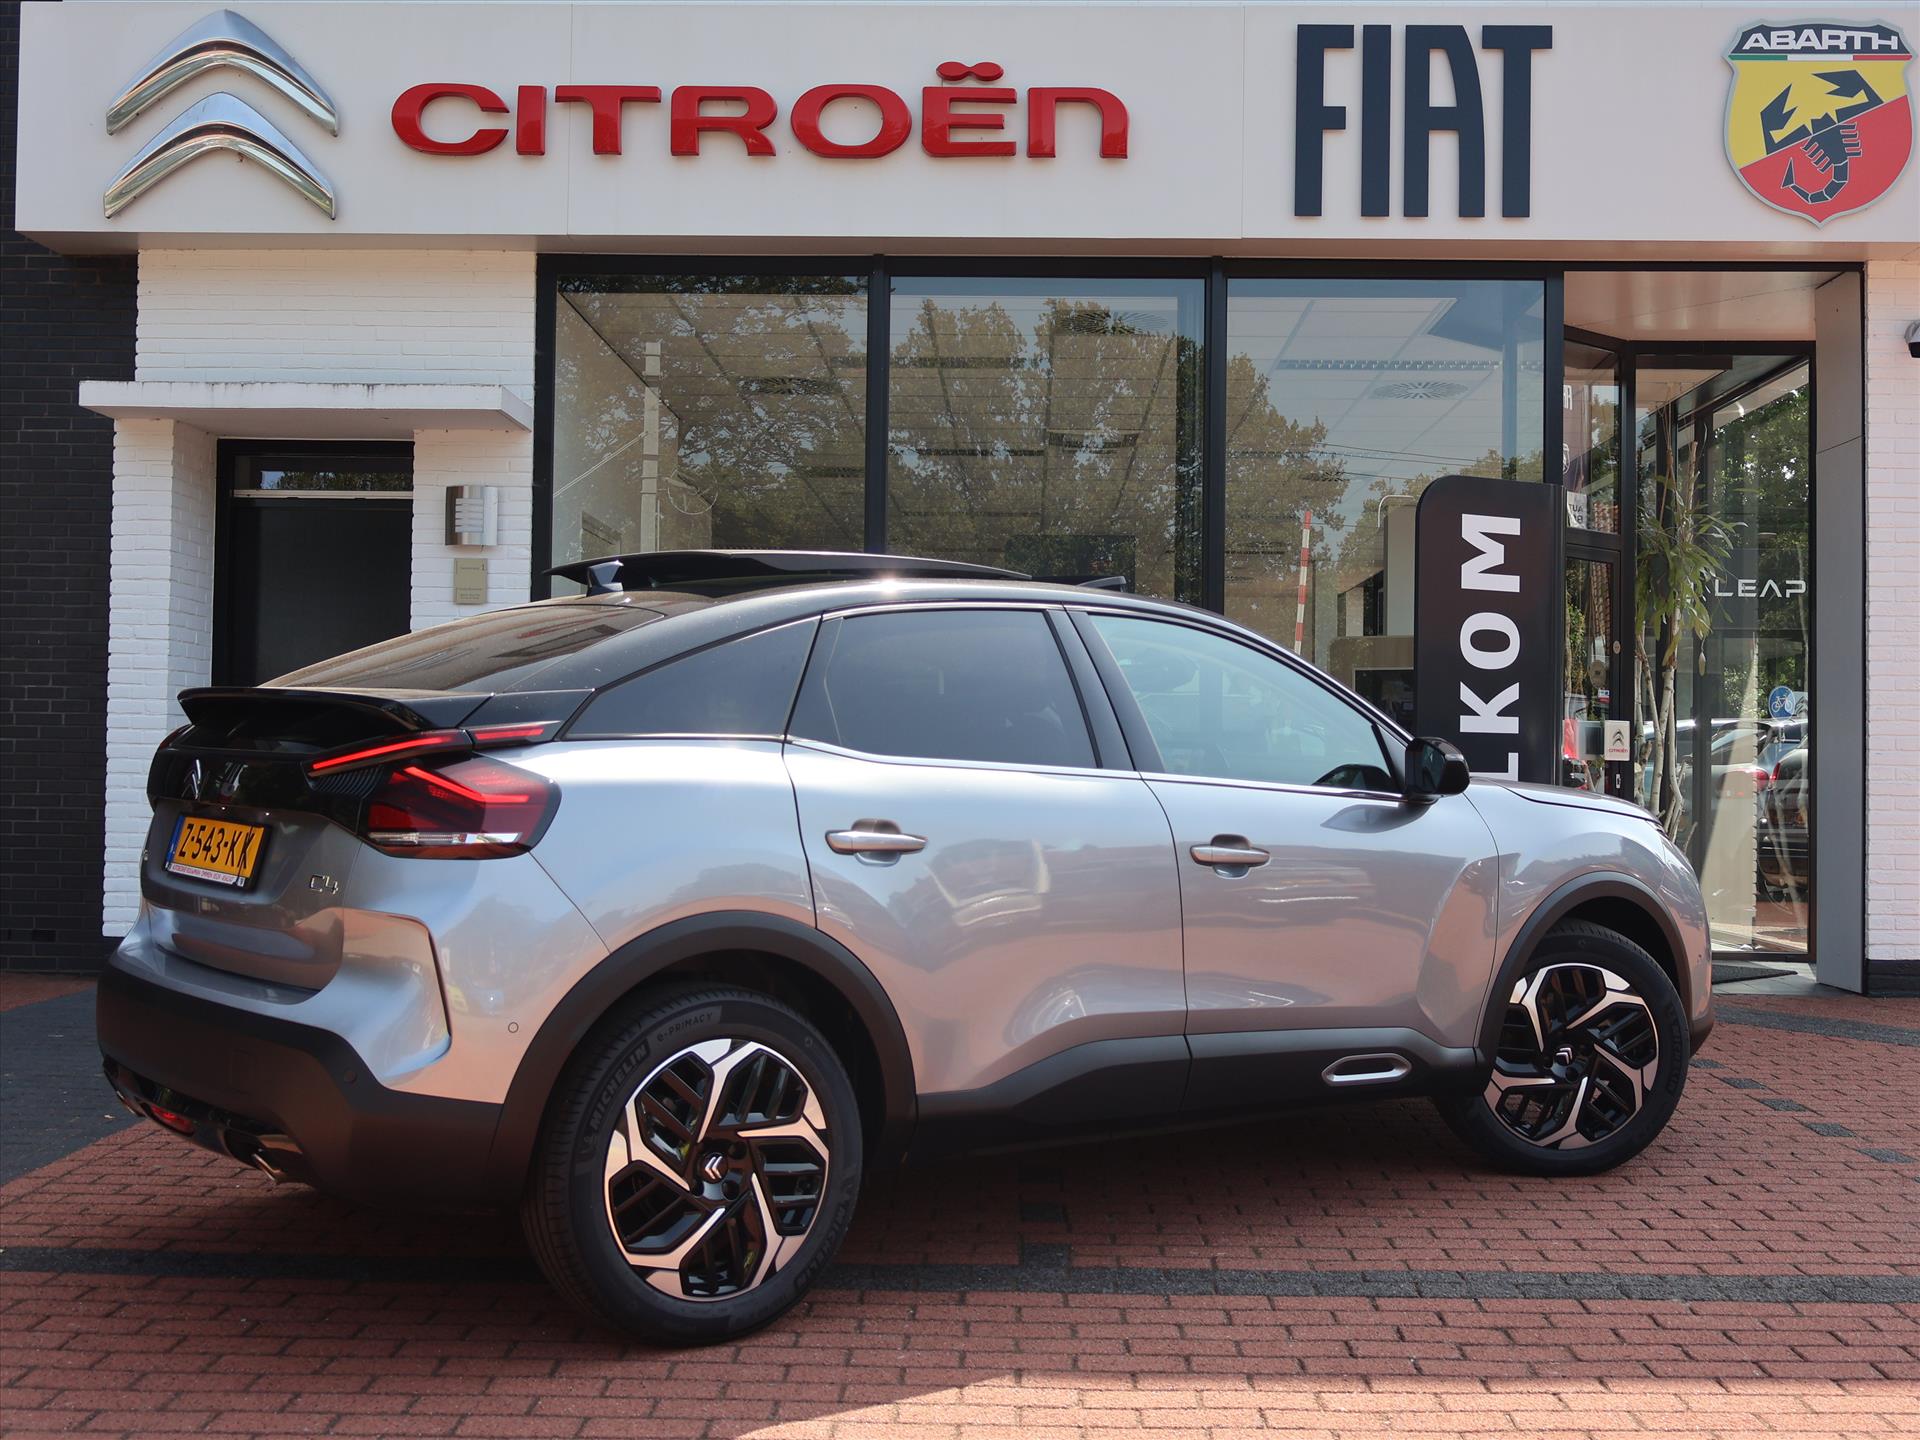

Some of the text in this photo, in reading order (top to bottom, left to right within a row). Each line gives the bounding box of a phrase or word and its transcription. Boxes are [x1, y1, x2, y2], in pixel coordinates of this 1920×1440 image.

[1742, 28, 1898, 50] ABARTH
[391, 61, 1129, 160] CITROËN
[1294, 24, 1553, 218] FIAT
[1714, 579, 1807, 598] LEAP
[178, 823, 256, 870] Z-543-KK
[310, 874, 339, 895] C4
[590, 1042, 649, 1132] MICHELIN
